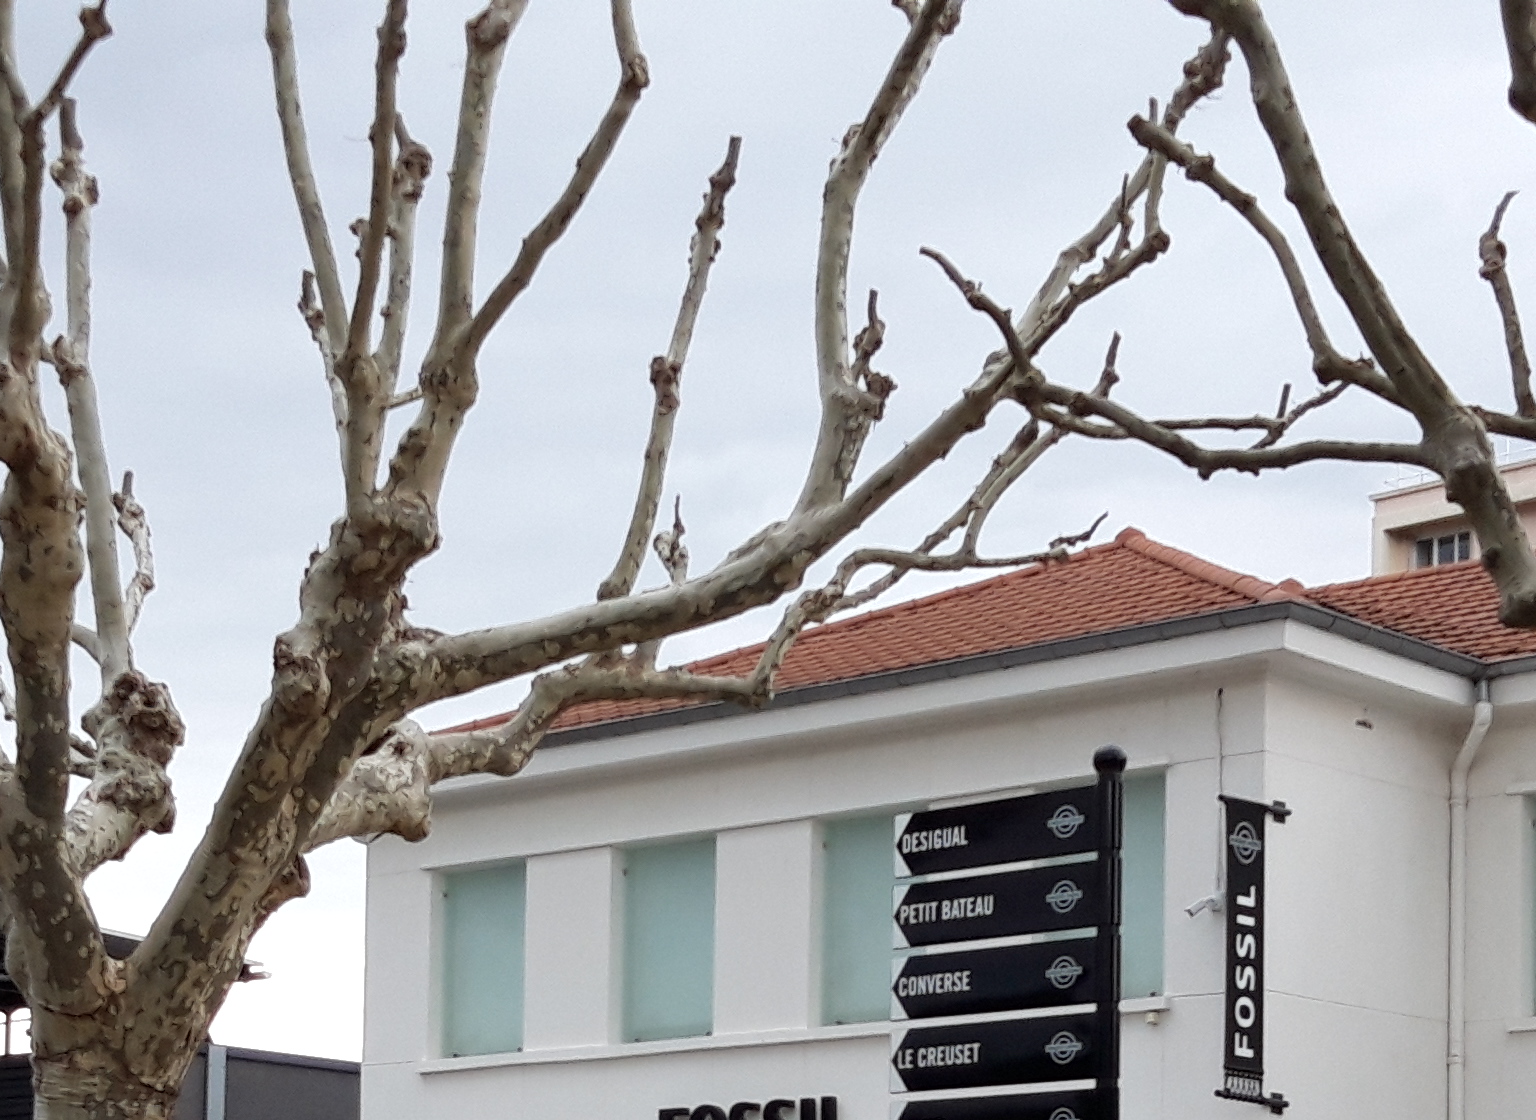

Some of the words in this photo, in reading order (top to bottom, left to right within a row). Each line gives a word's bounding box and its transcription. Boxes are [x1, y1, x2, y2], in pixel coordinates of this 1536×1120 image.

[902, 825, 968, 855] DESIGUAL
[900, 901, 939, 925] PETIT
[941, 894, 994, 921] BATEAU
[898, 971, 972, 997] CONVERSE
[1234, 885, 1256, 1059] FOSSIL
[897, 1049, 914, 1069] LE
[917, 1043, 981, 1068] CREUSET
